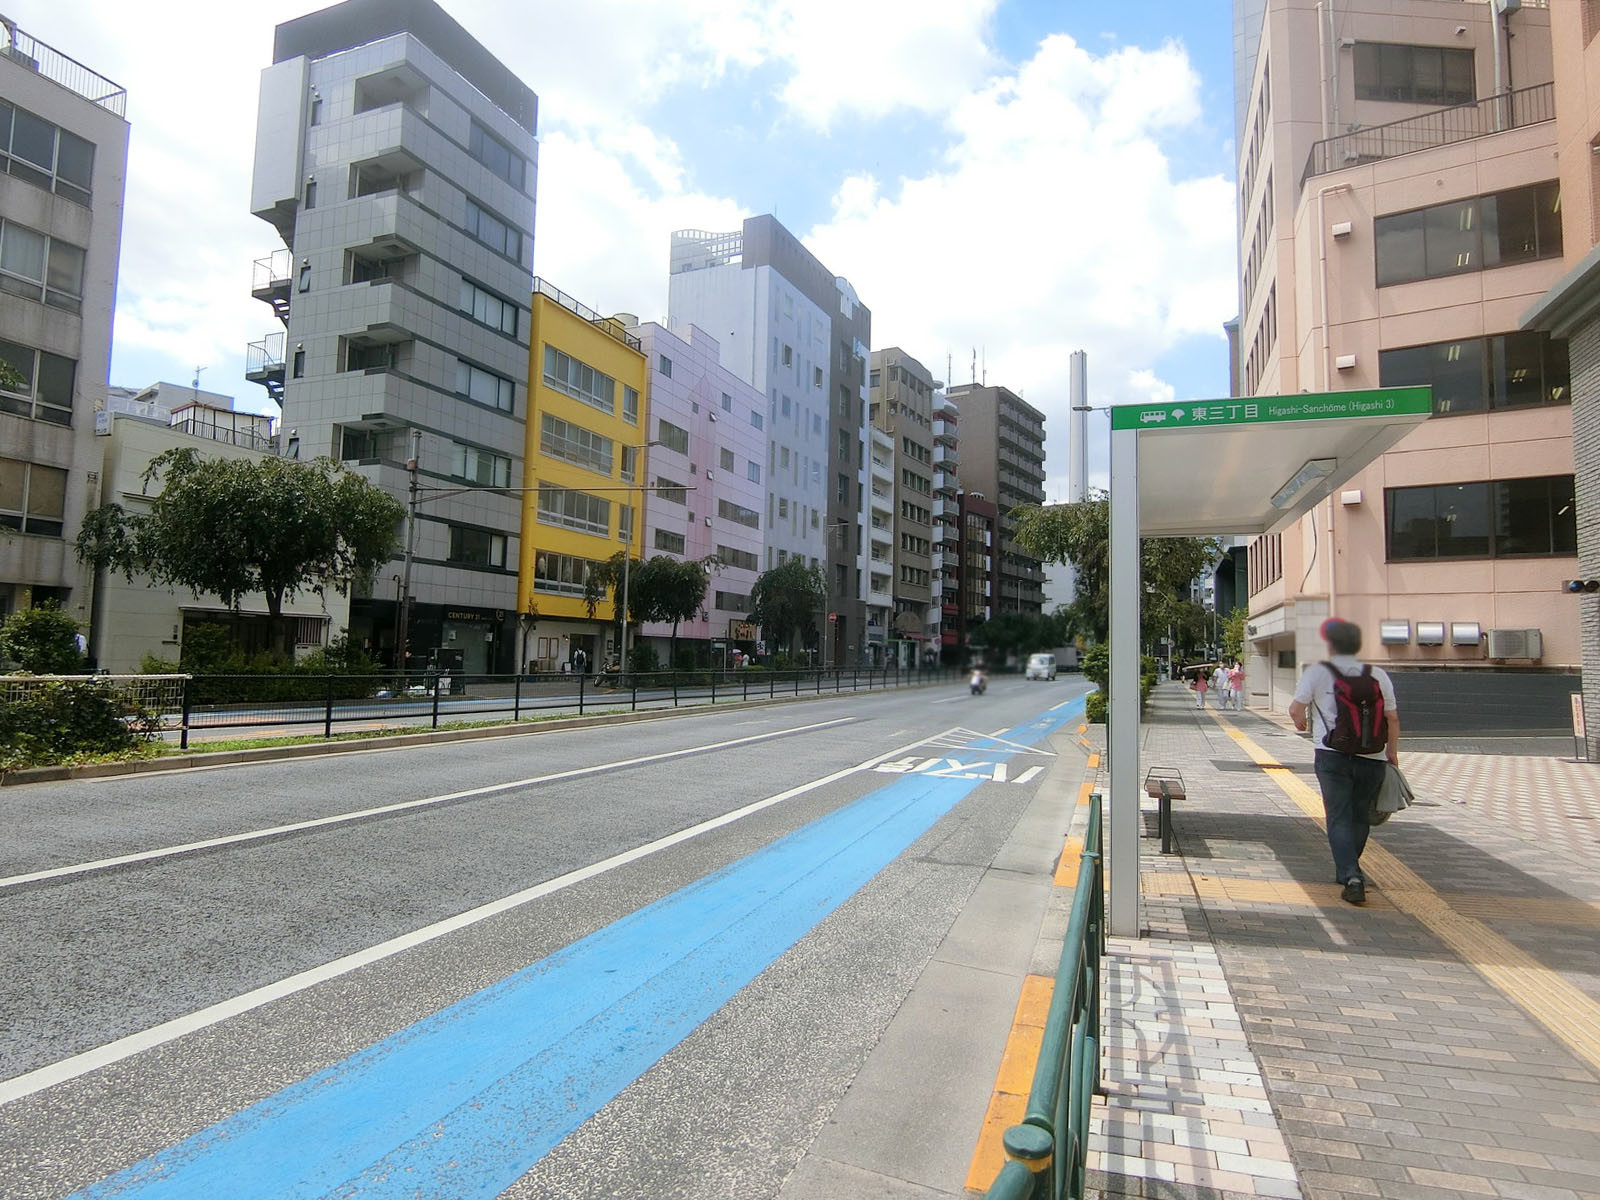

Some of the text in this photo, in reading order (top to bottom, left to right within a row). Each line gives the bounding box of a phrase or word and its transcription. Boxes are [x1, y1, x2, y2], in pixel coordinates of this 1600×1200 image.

[1348, 400, 1383, 412] (Higashi
[1386, 399, 1395, 410] 3)
[1192, 404, 1259, 421] 東三丁目
[448, 611, 474, 620] CENTURY
